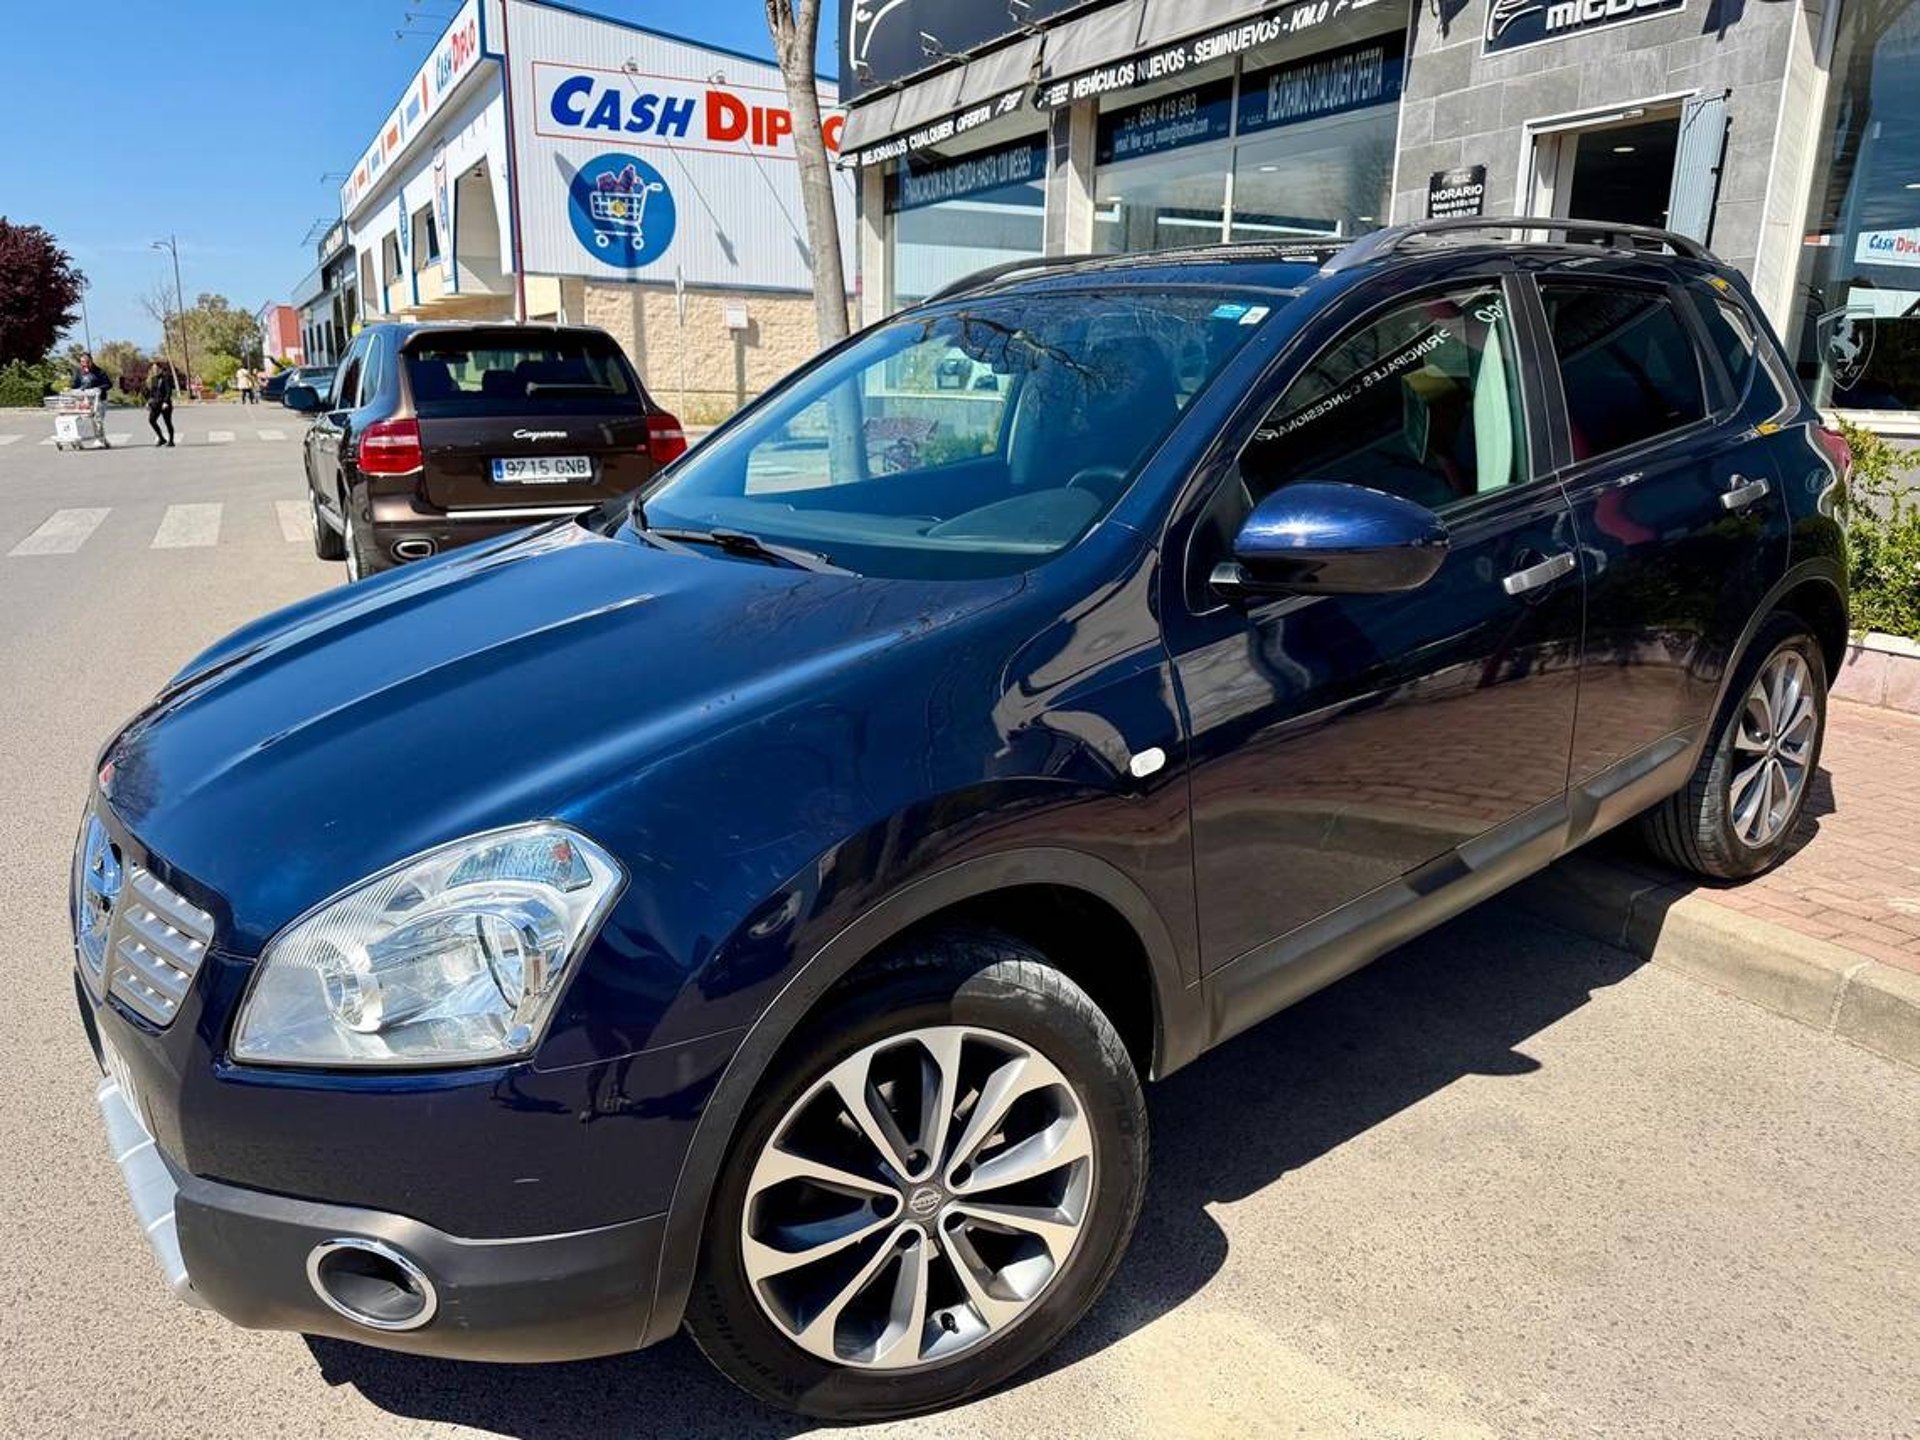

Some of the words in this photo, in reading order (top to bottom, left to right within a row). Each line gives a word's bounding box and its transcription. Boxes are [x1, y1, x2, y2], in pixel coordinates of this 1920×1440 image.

[1073, 63, 1134, 99] VEHÍCULOS
[1137, 48, 1185, 81] NUEVOS
[1194, 16, 1280, 64] SEMINUEVOS
[550, 75, 696, 138] CASH
[706, 90, 847, 152] DIPO
[909, 120, 954, 150] CUALQUIER
[956, 106, 991, 132] OFERTA
[1431, 184, 1483, 202] HORARIO
[505, 461, 550, 476] 9715
[555, 459, 587, 474] GNB
